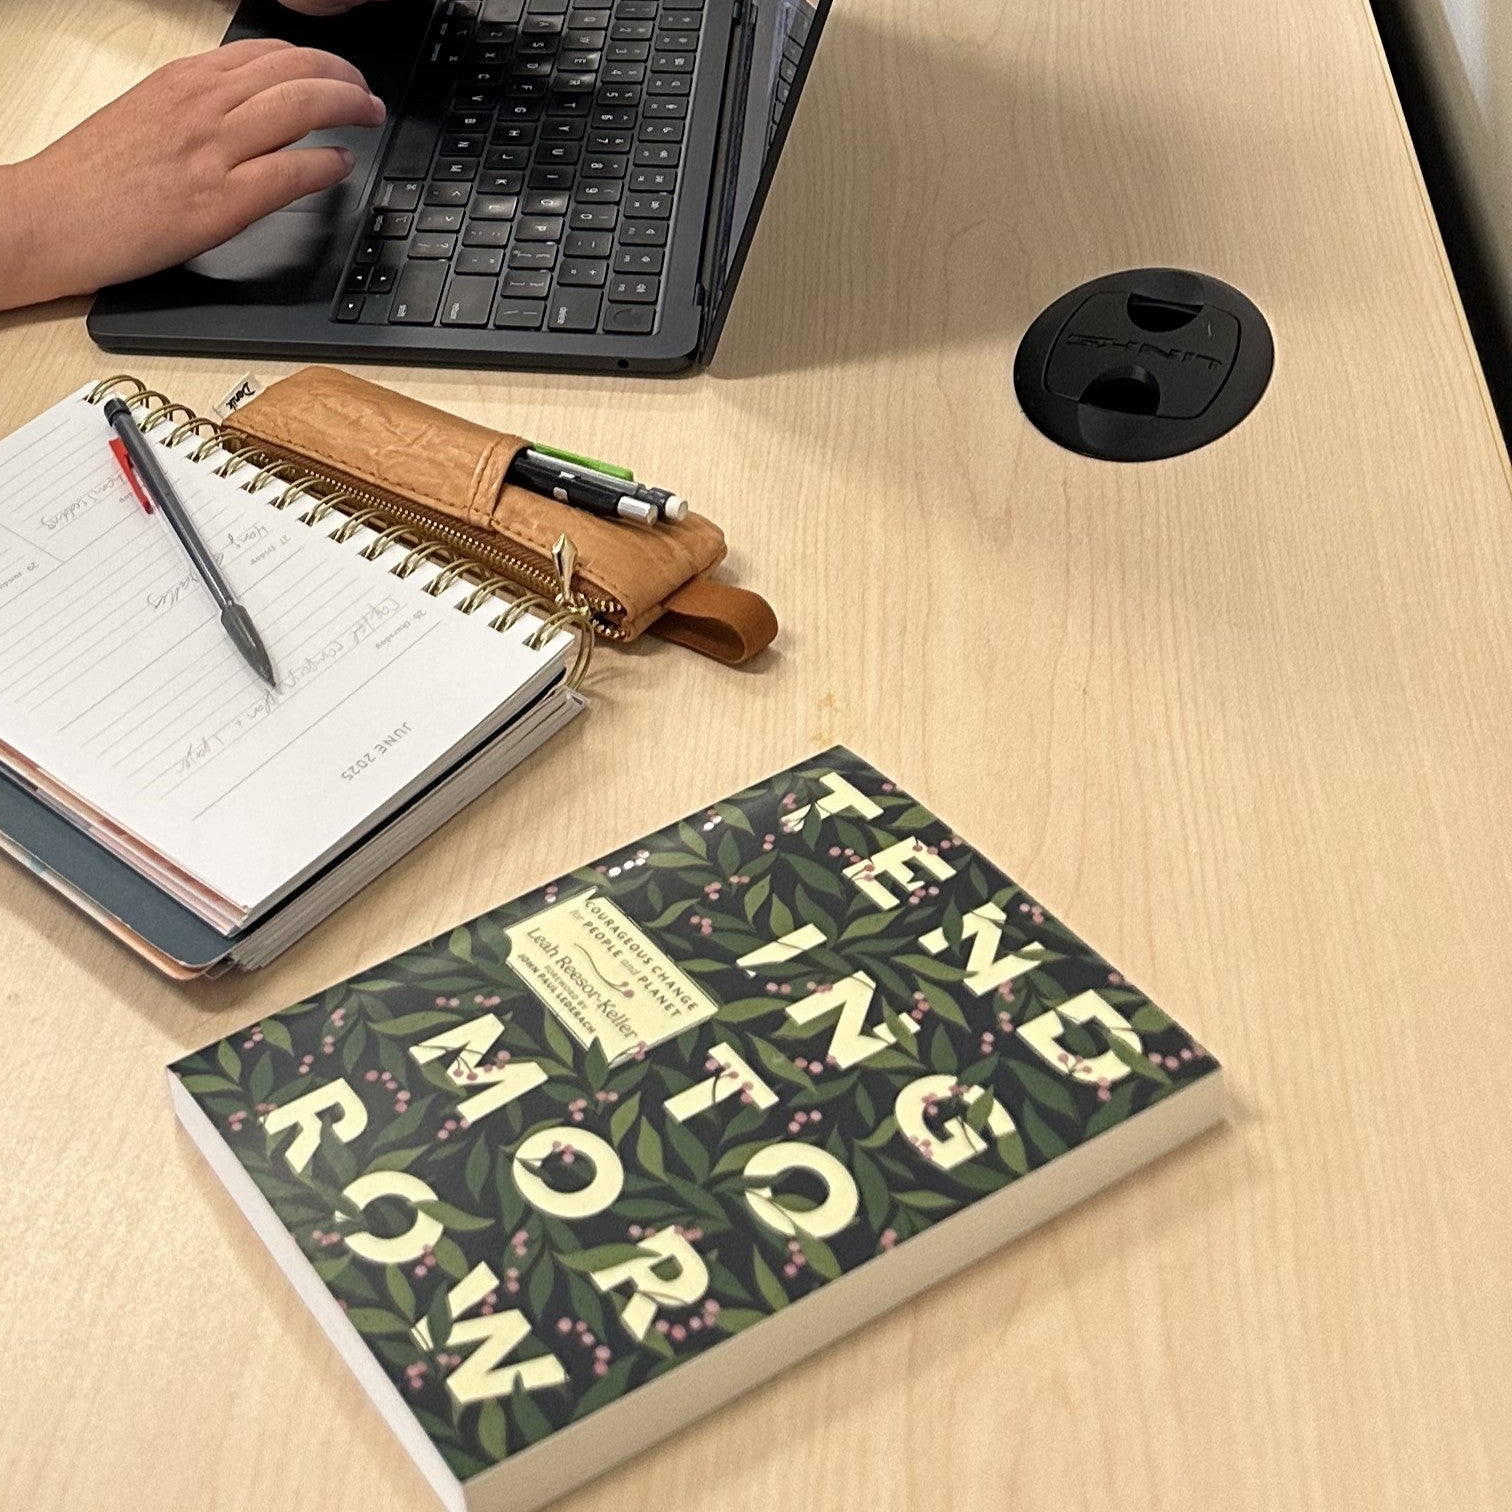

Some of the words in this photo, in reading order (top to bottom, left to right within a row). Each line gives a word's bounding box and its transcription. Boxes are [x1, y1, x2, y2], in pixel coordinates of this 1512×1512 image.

[375, 619, 411, 650] thursday
[340, 751, 376, 782] 2025
[374, 720, 417, 756] JUNE
[527, 927, 559, 958] Leah
[555, 955, 639, 1039] Reesor-Keller
[583, 921, 623, 959] PEOPLE
[621, 958, 641, 976] and
[638, 974, 682, 1018] PLANET
[584, 900, 653, 965] COURAGEOUS
[652, 964, 699, 1011] CHANGE
[782, 772, 1146, 1085] TEND
[517, 952, 541, 975] JOHN
[537, 972, 557, 995] PAUL
[555, 991, 597, 1035] LEDERACH
[543, 964, 579, 1001] FOREWORD
[575, 999, 588, 1011] BY
[734, 922, 1015, 1168] ING
[409, 1012, 710, 1341] MOR
[662, 1043, 859, 1240] TO
[262, 1078, 570, 1402] ROW
